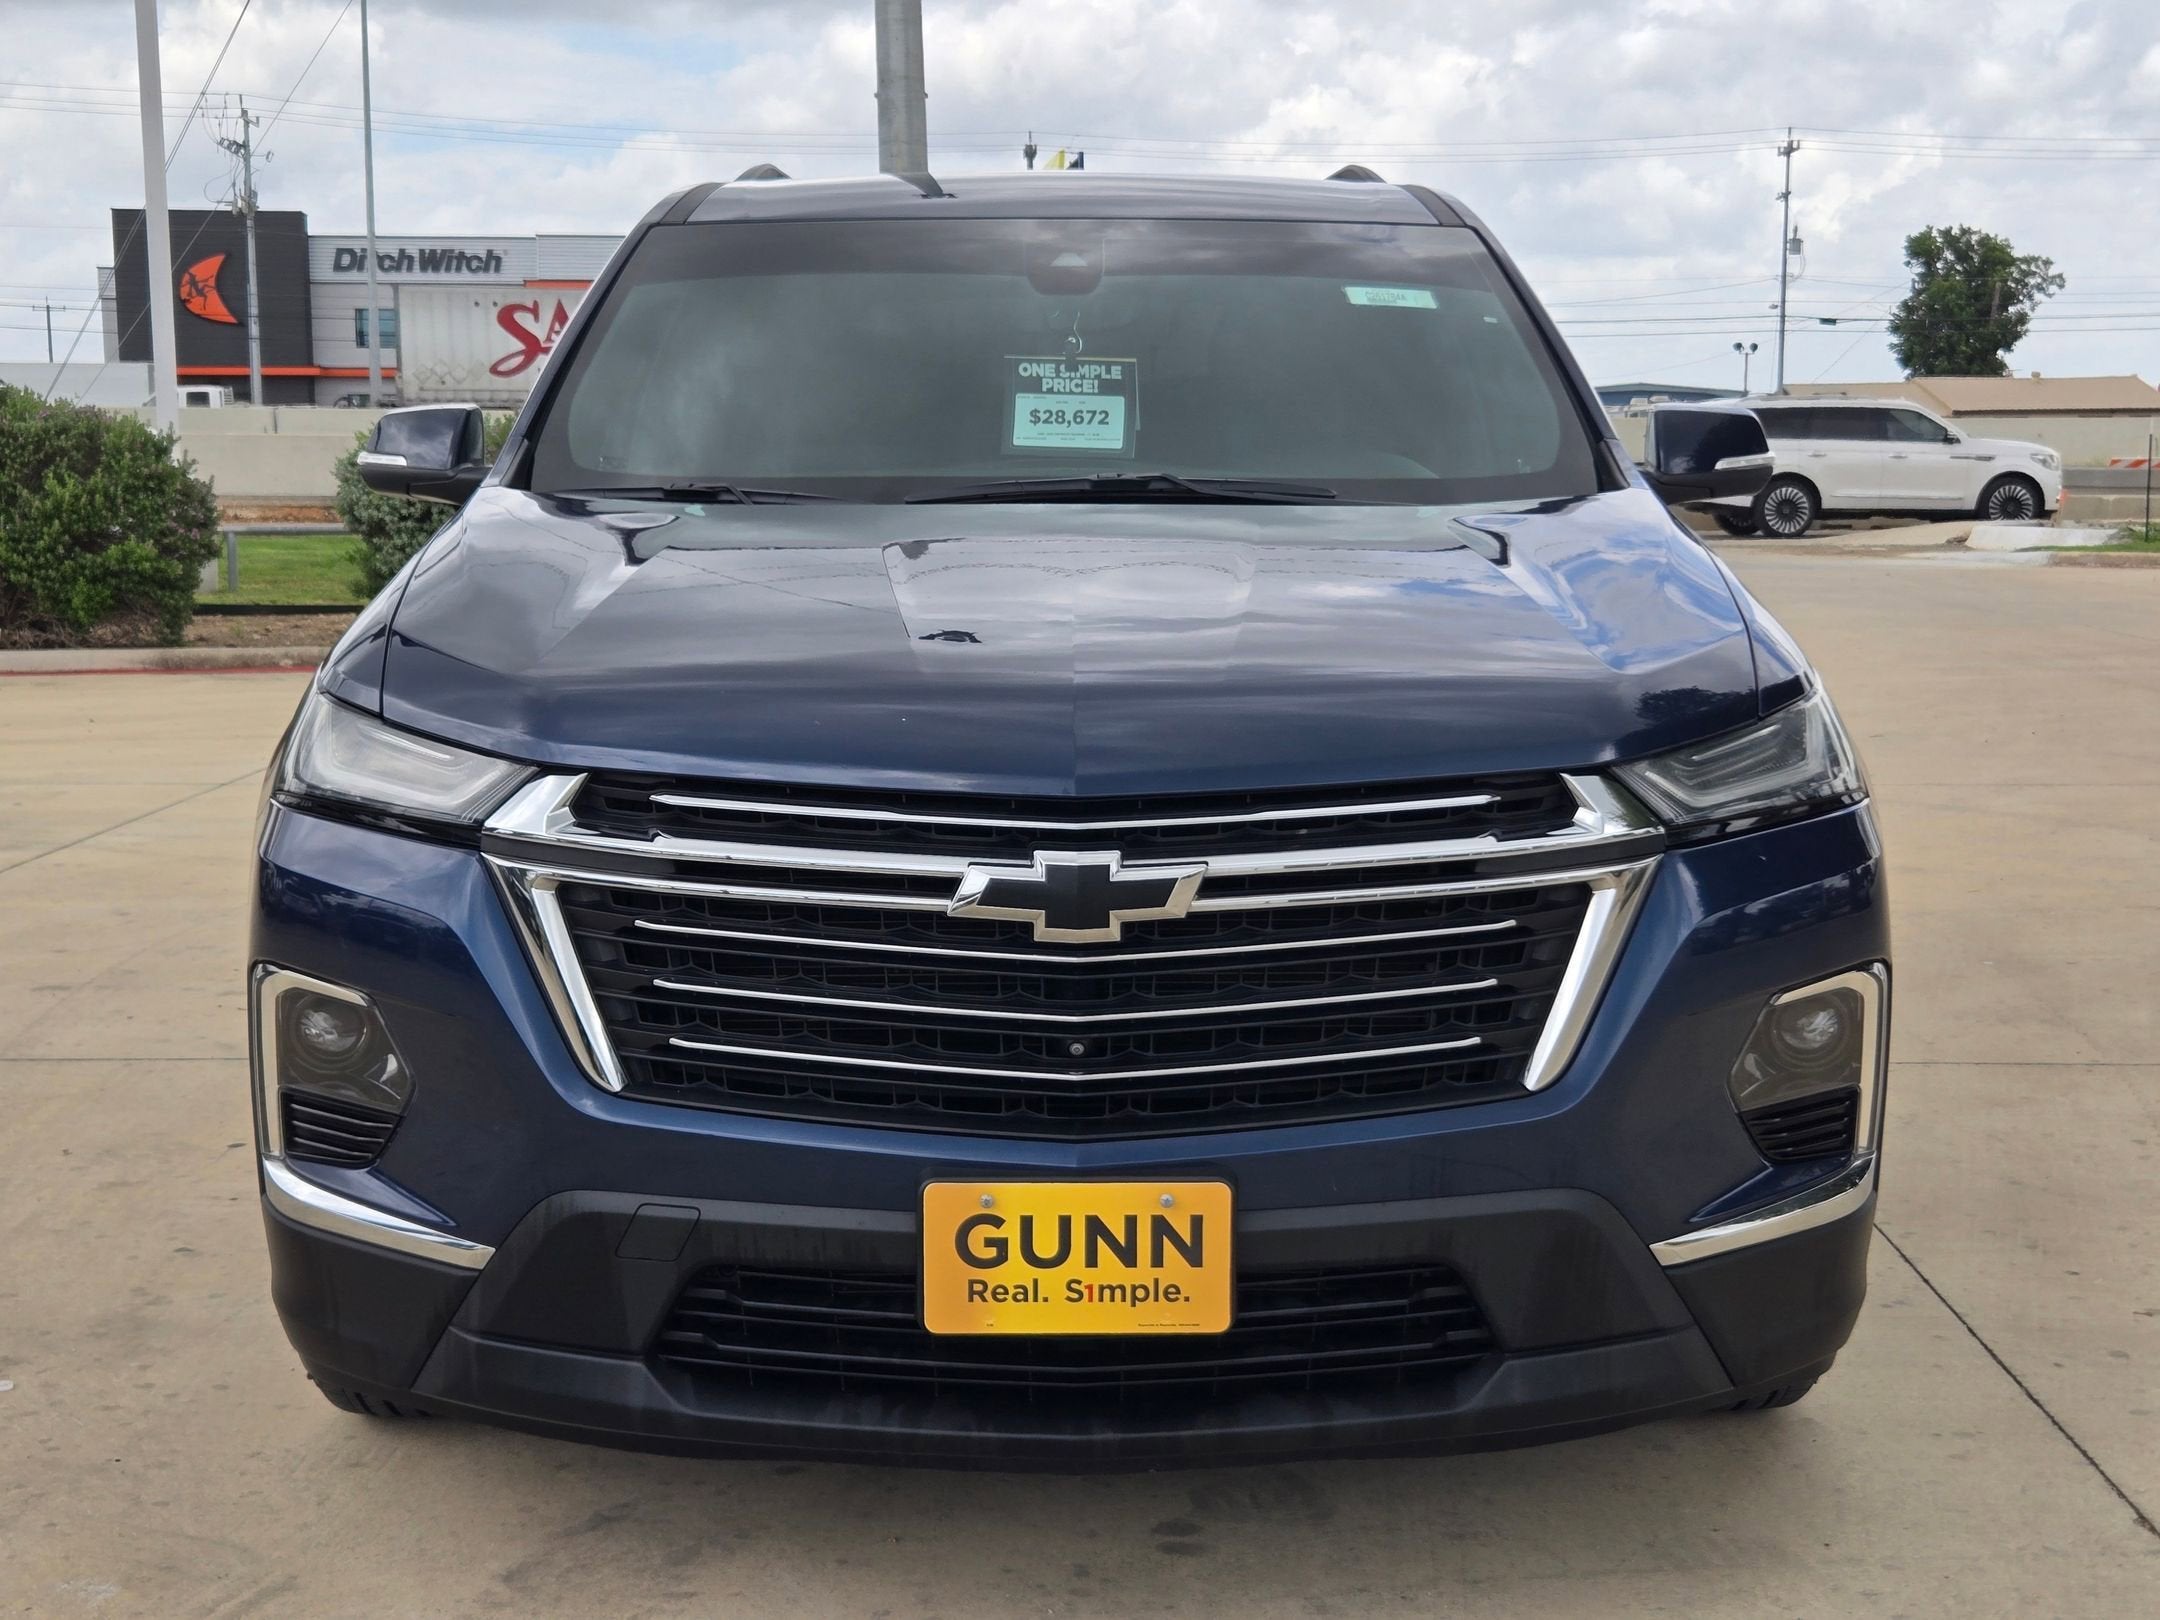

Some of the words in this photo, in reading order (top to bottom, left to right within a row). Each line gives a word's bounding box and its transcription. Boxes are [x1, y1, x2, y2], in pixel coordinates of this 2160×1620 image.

[333, 248, 415, 273] Dich
[418, 248, 503, 274] Witch
[1018, 363, 1056, 378] ONE
[1041, 378, 1099, 393] PRICE!
[1029, 408, 1110, 428] $28,672
[954, 1213, 1204, 1269] GUNN
[967, 1278, 1049, 1304] Real.
